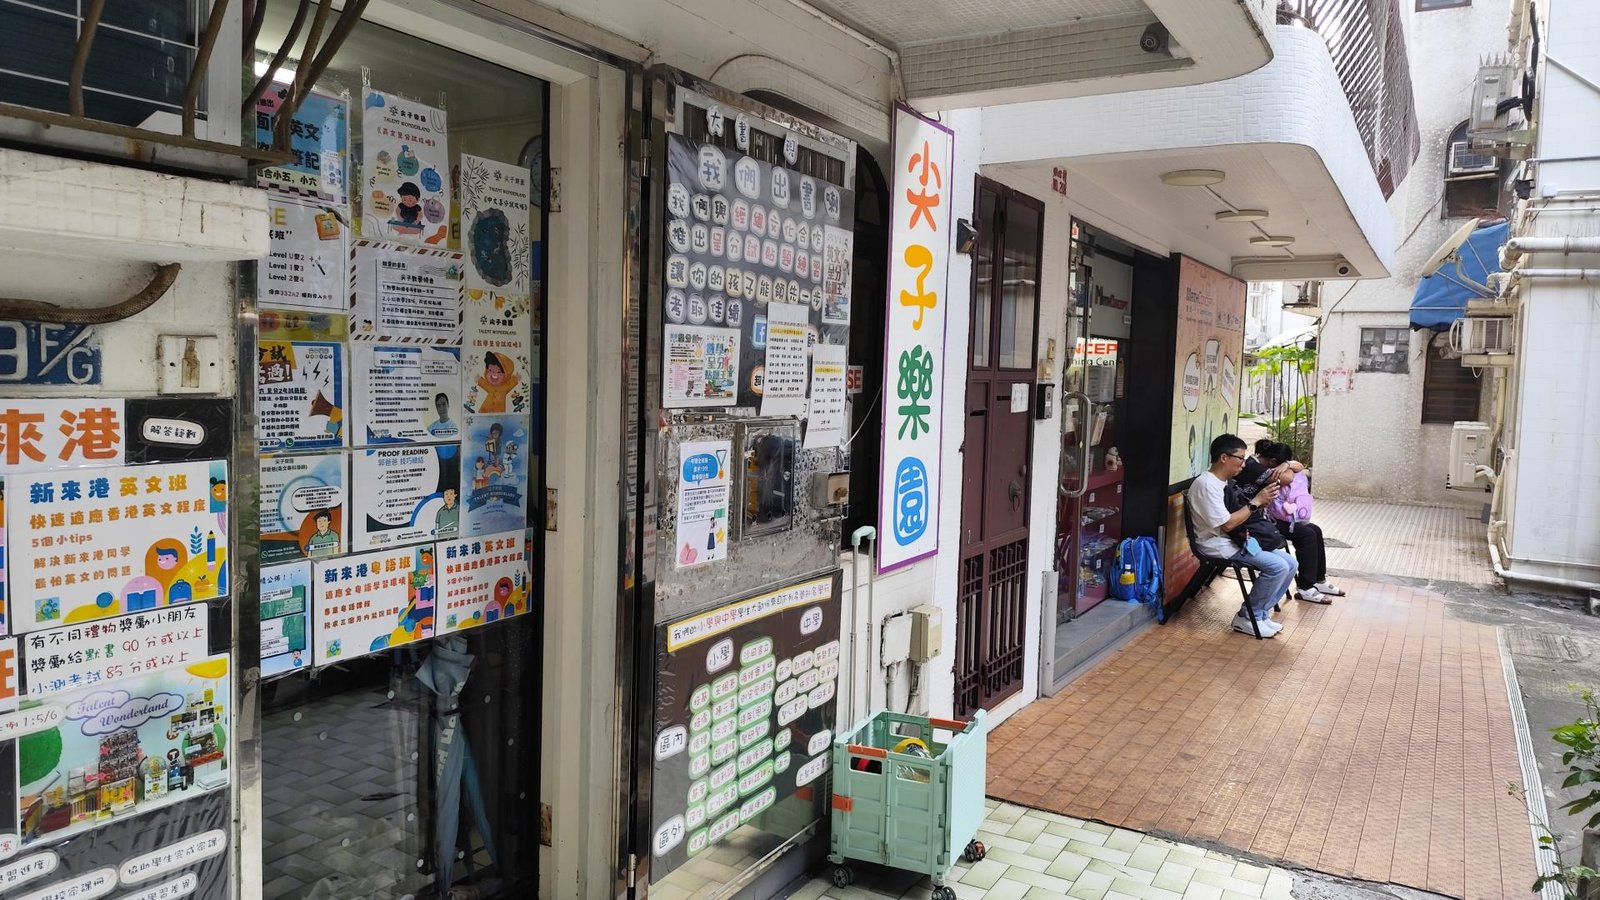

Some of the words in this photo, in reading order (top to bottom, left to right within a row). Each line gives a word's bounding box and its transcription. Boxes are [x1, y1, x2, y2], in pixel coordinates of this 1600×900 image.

[257, 109, 320, 142] 面英文
[383, 116, 401, 126] TALENT
[401, 121, 431, 134] WONDERLAND
[269, 262, 287, 270] Level
[269, 273, 287, 281] Level
[891, 139, 943, 548] 尖子樂園
[378, 450, 400, 458] PROOF
[30, 477, 110, 504] 新來港
[119, 474, 188, 497] 英文班
[30, 499, 207, 530] 快速適應香港英文程度
[33, 546, 131, 569] 解決新來港同學
[446, 541, 482, 560] 新來港
[484, 537, 516, 554] 英文班
[324, 555, 412, 584] 新來港粵語班
[30, 606, 197, 649] 有不同禮物獎勵小朋友
[122, 639, 140, 653] 90
[146, 627, 205, 648] 分或以上
[106, 664, 124, 680] 85
[130, 651, 190, 674] 分或以上
[77, 697, 117, 715] Talent
[100, 701, 170, 728] Wonderland
